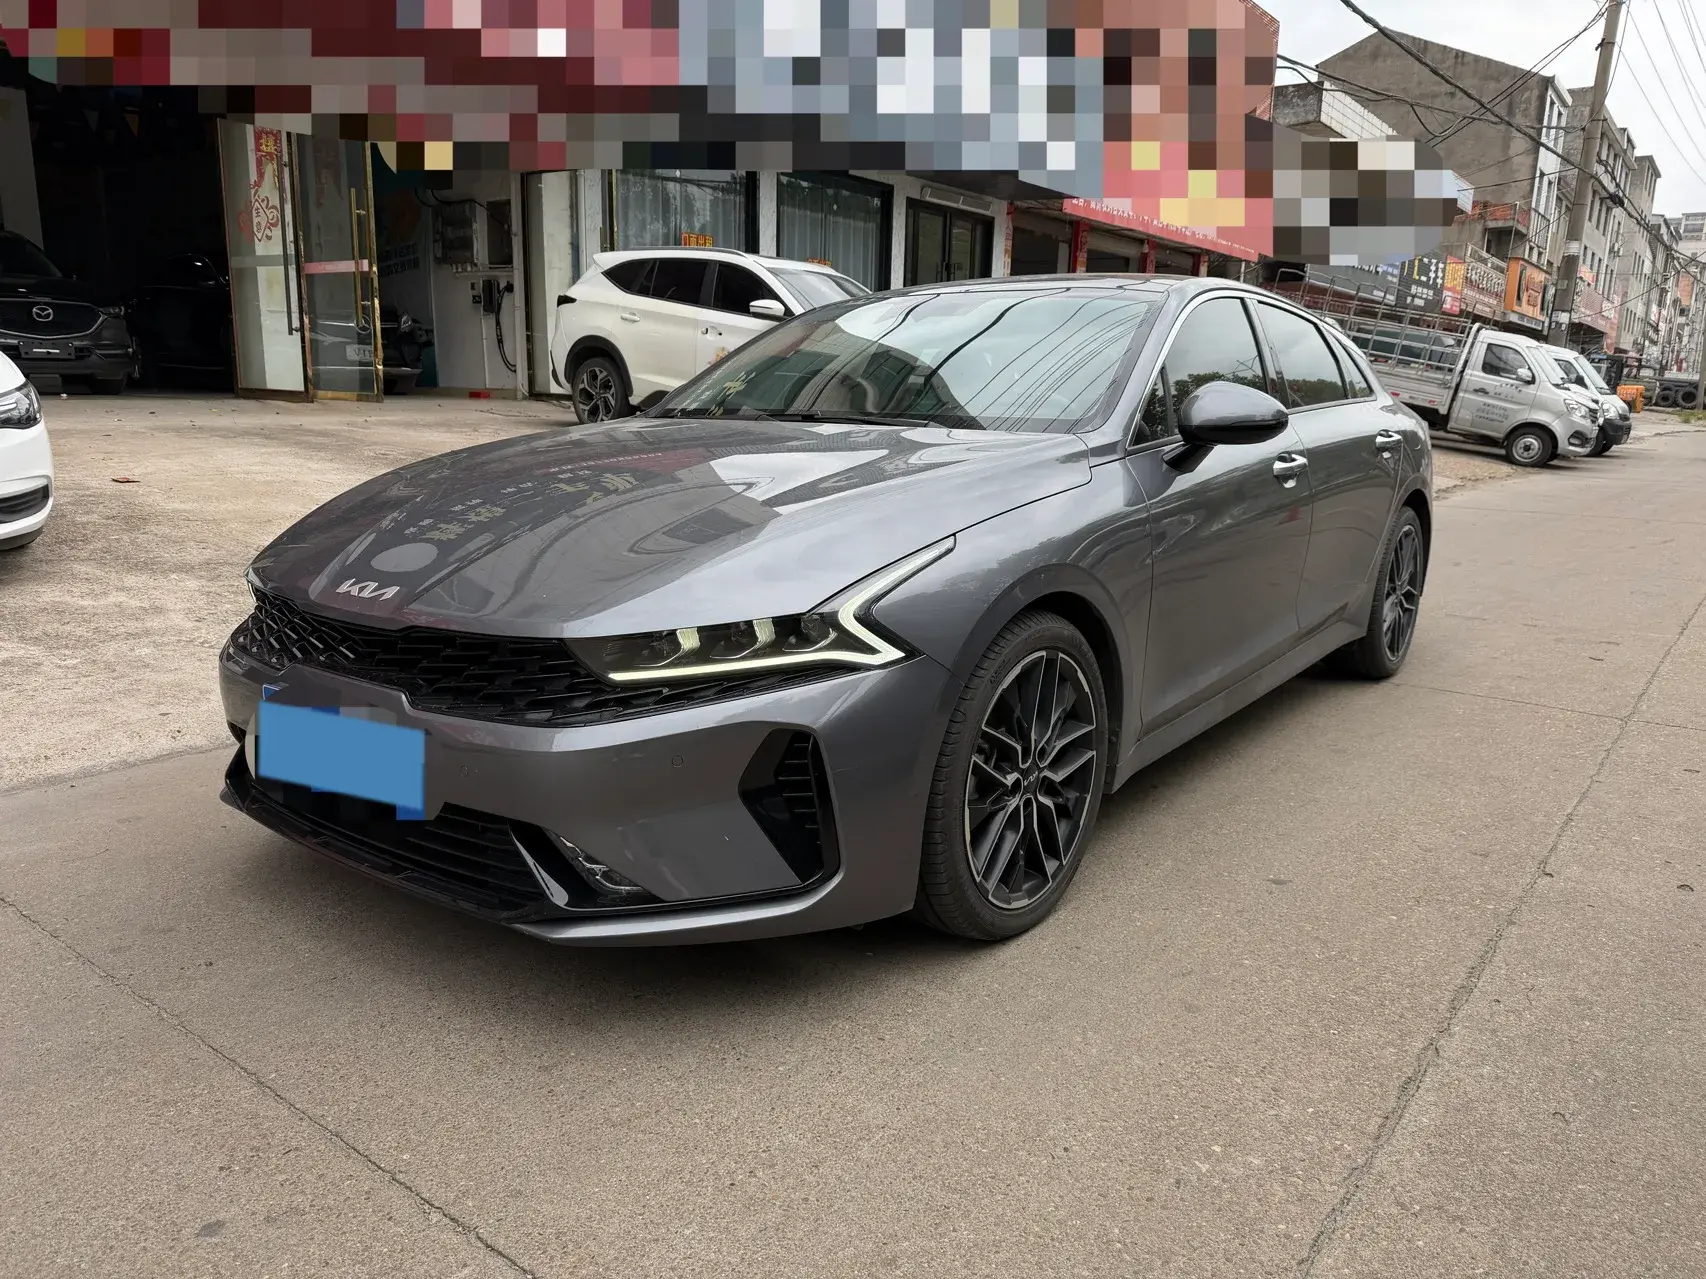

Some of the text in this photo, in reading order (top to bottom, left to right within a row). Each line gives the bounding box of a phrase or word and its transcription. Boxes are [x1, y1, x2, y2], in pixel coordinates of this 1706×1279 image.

[681, 233, 713, 248] 门面出租
[335, 578, 400, 601] KIA
